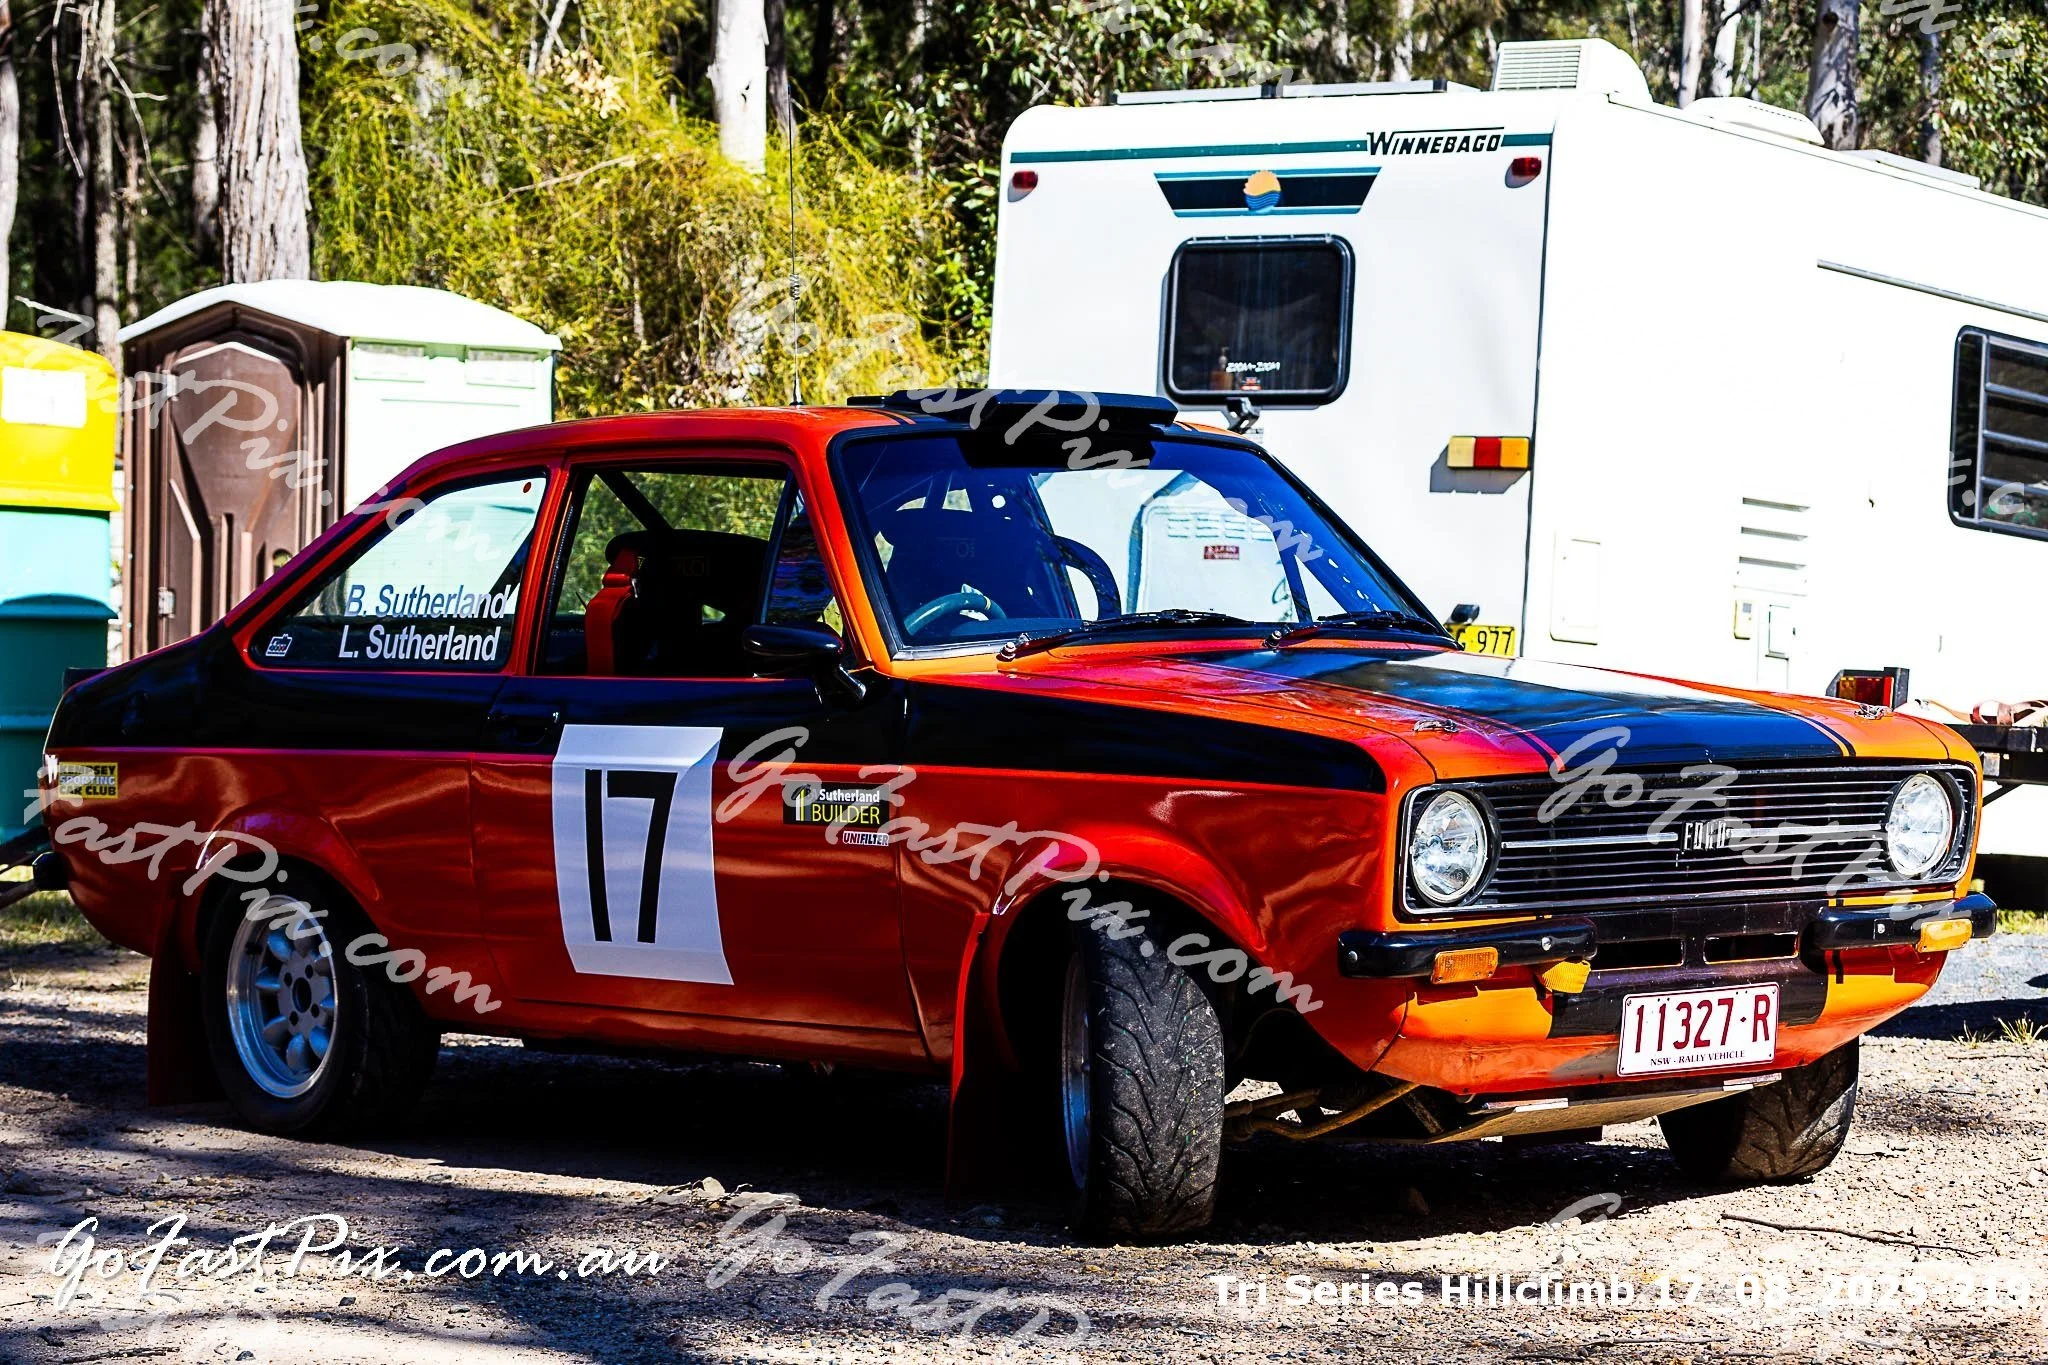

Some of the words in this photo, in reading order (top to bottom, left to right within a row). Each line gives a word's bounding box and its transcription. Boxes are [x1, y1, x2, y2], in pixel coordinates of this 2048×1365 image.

[1366, 129, 1502, 156] WINNEBAGO
[344, 584, 367, 618] B.
[375, 584, 511, 618] Sutherland
[338, 624, 359, 659] L.
[366, 624, 502, 661] Sutherland
[60, 776, 115, 785] SPORTING
[59, 786, 83, 795] CAR
[85, 786, 116, 795] CLUB
[819, 788, 880, 803] Sutherland
[812, 803, 880, 824] BUILDER
[843, 832, 889, 846] UNIFILTER
[585, 768, 679, 944] 17
[1650, 1057, 1671, 1066] NSW
[1678, 1053, 1706, 1064] RALLY
[1708, 1050, 1746, 1061] VEHICLE
